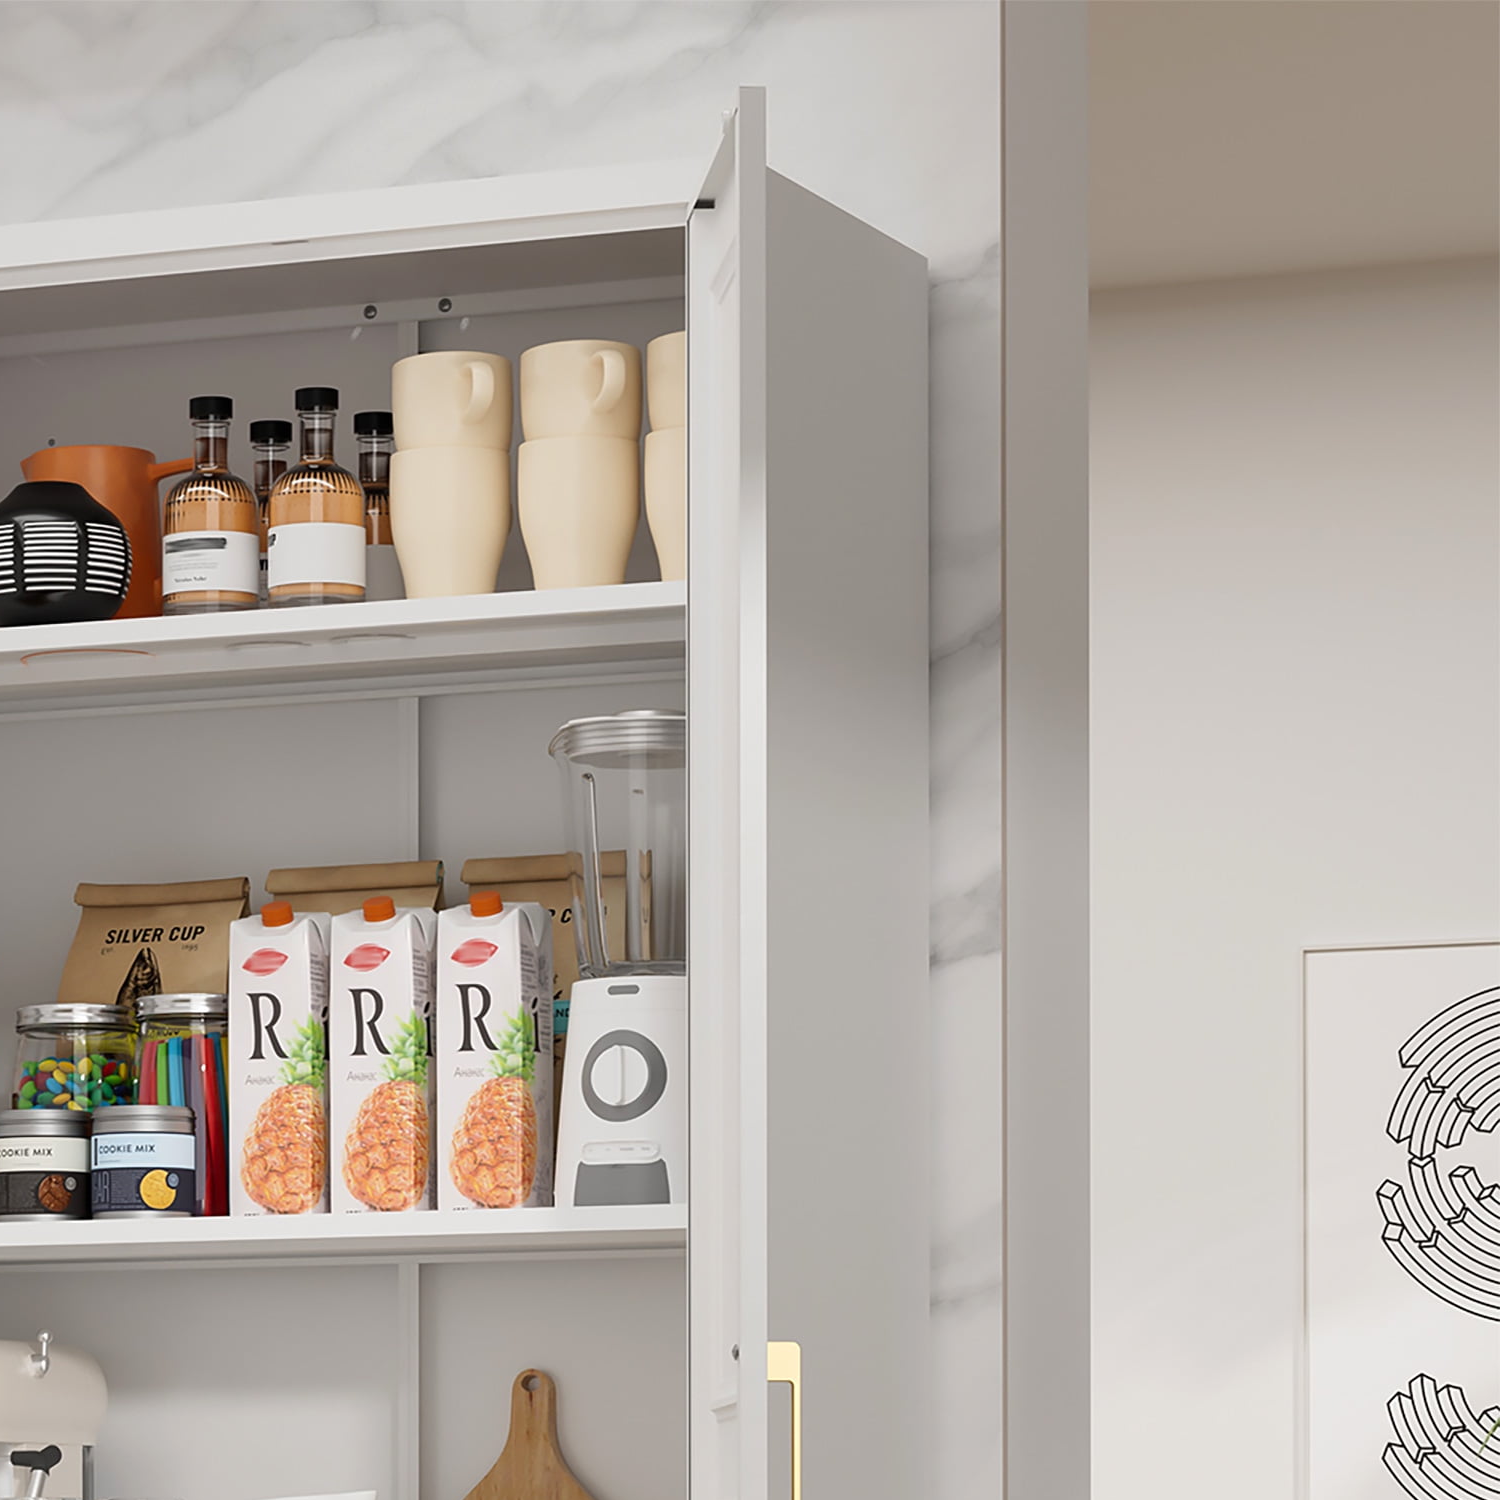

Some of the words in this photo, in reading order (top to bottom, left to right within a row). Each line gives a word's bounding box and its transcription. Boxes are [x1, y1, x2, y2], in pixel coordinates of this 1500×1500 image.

[104, 927, 164, 945] SILVER
[168, 925, 205, 942] CUP
[33, 1147, 53, 1158] MIX
[99, 1144, 133, 1155] COOKIE
[135, 1144, 156, 1154] MIX
